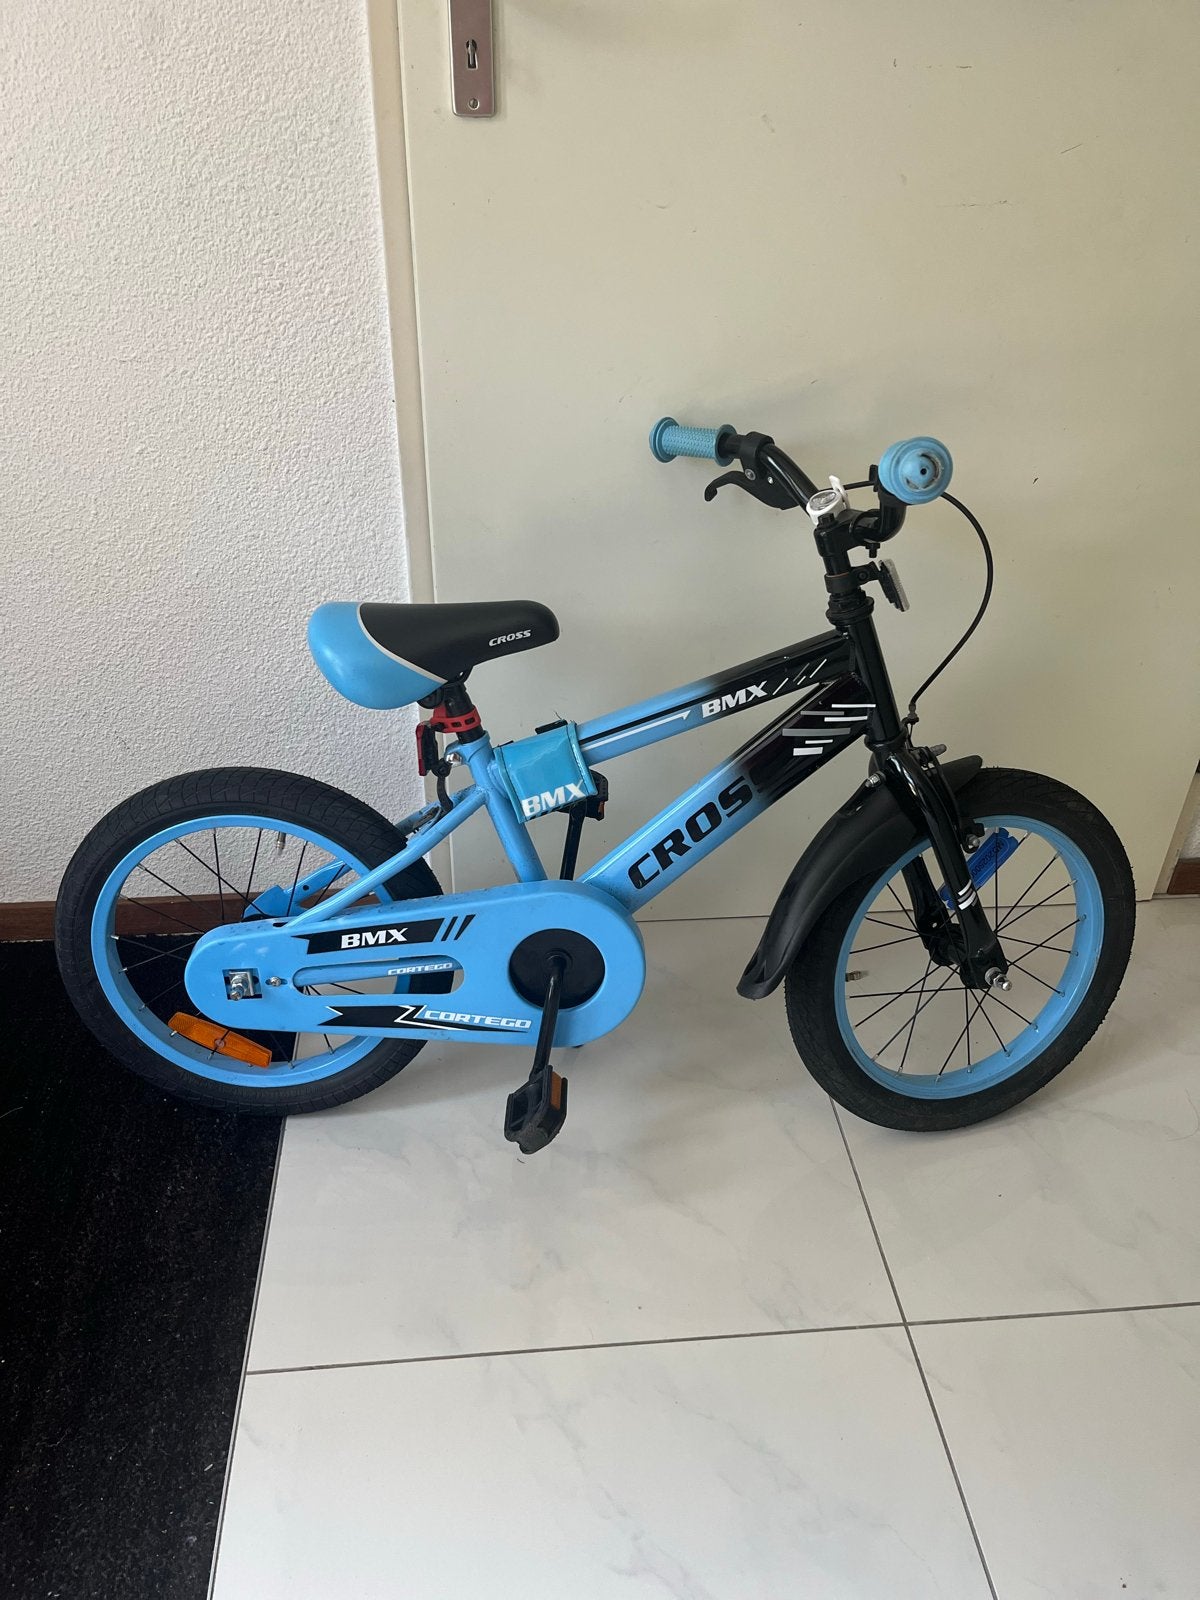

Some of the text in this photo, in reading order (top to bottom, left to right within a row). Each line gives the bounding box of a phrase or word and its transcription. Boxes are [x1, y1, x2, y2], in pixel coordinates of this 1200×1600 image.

[489, 629, 531, 647] CROSS
[701, 681, 767, 718] BMX
[521, 779, 586, 817] BMX
[340, 927, 408, 949] BMX
[387, 962, 453, 976] CORTEGO
[423, 1010, 532, 1029] CORTEGO
